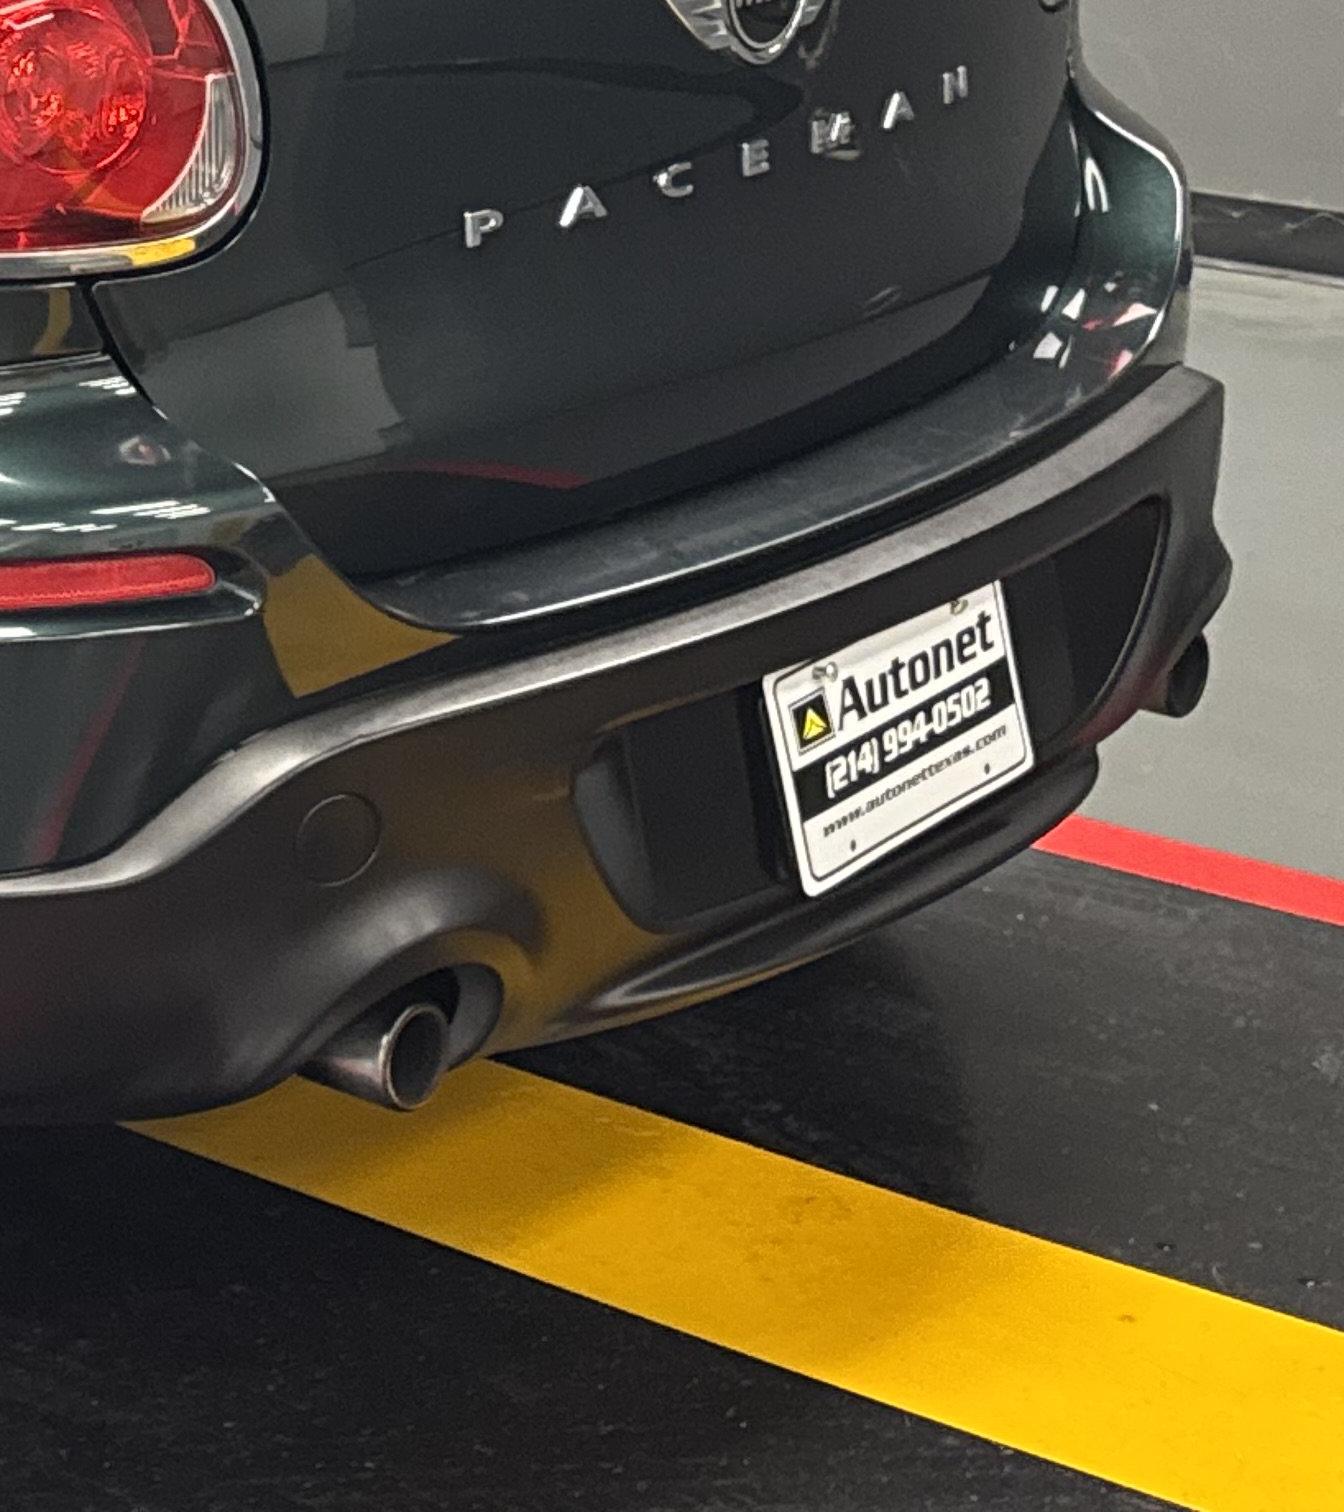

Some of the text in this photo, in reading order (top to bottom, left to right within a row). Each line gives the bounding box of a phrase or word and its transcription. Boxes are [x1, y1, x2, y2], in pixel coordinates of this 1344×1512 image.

[837, 610, 996, 731] Autonet
[825, 677, 993, 799] (214) 994-0502
